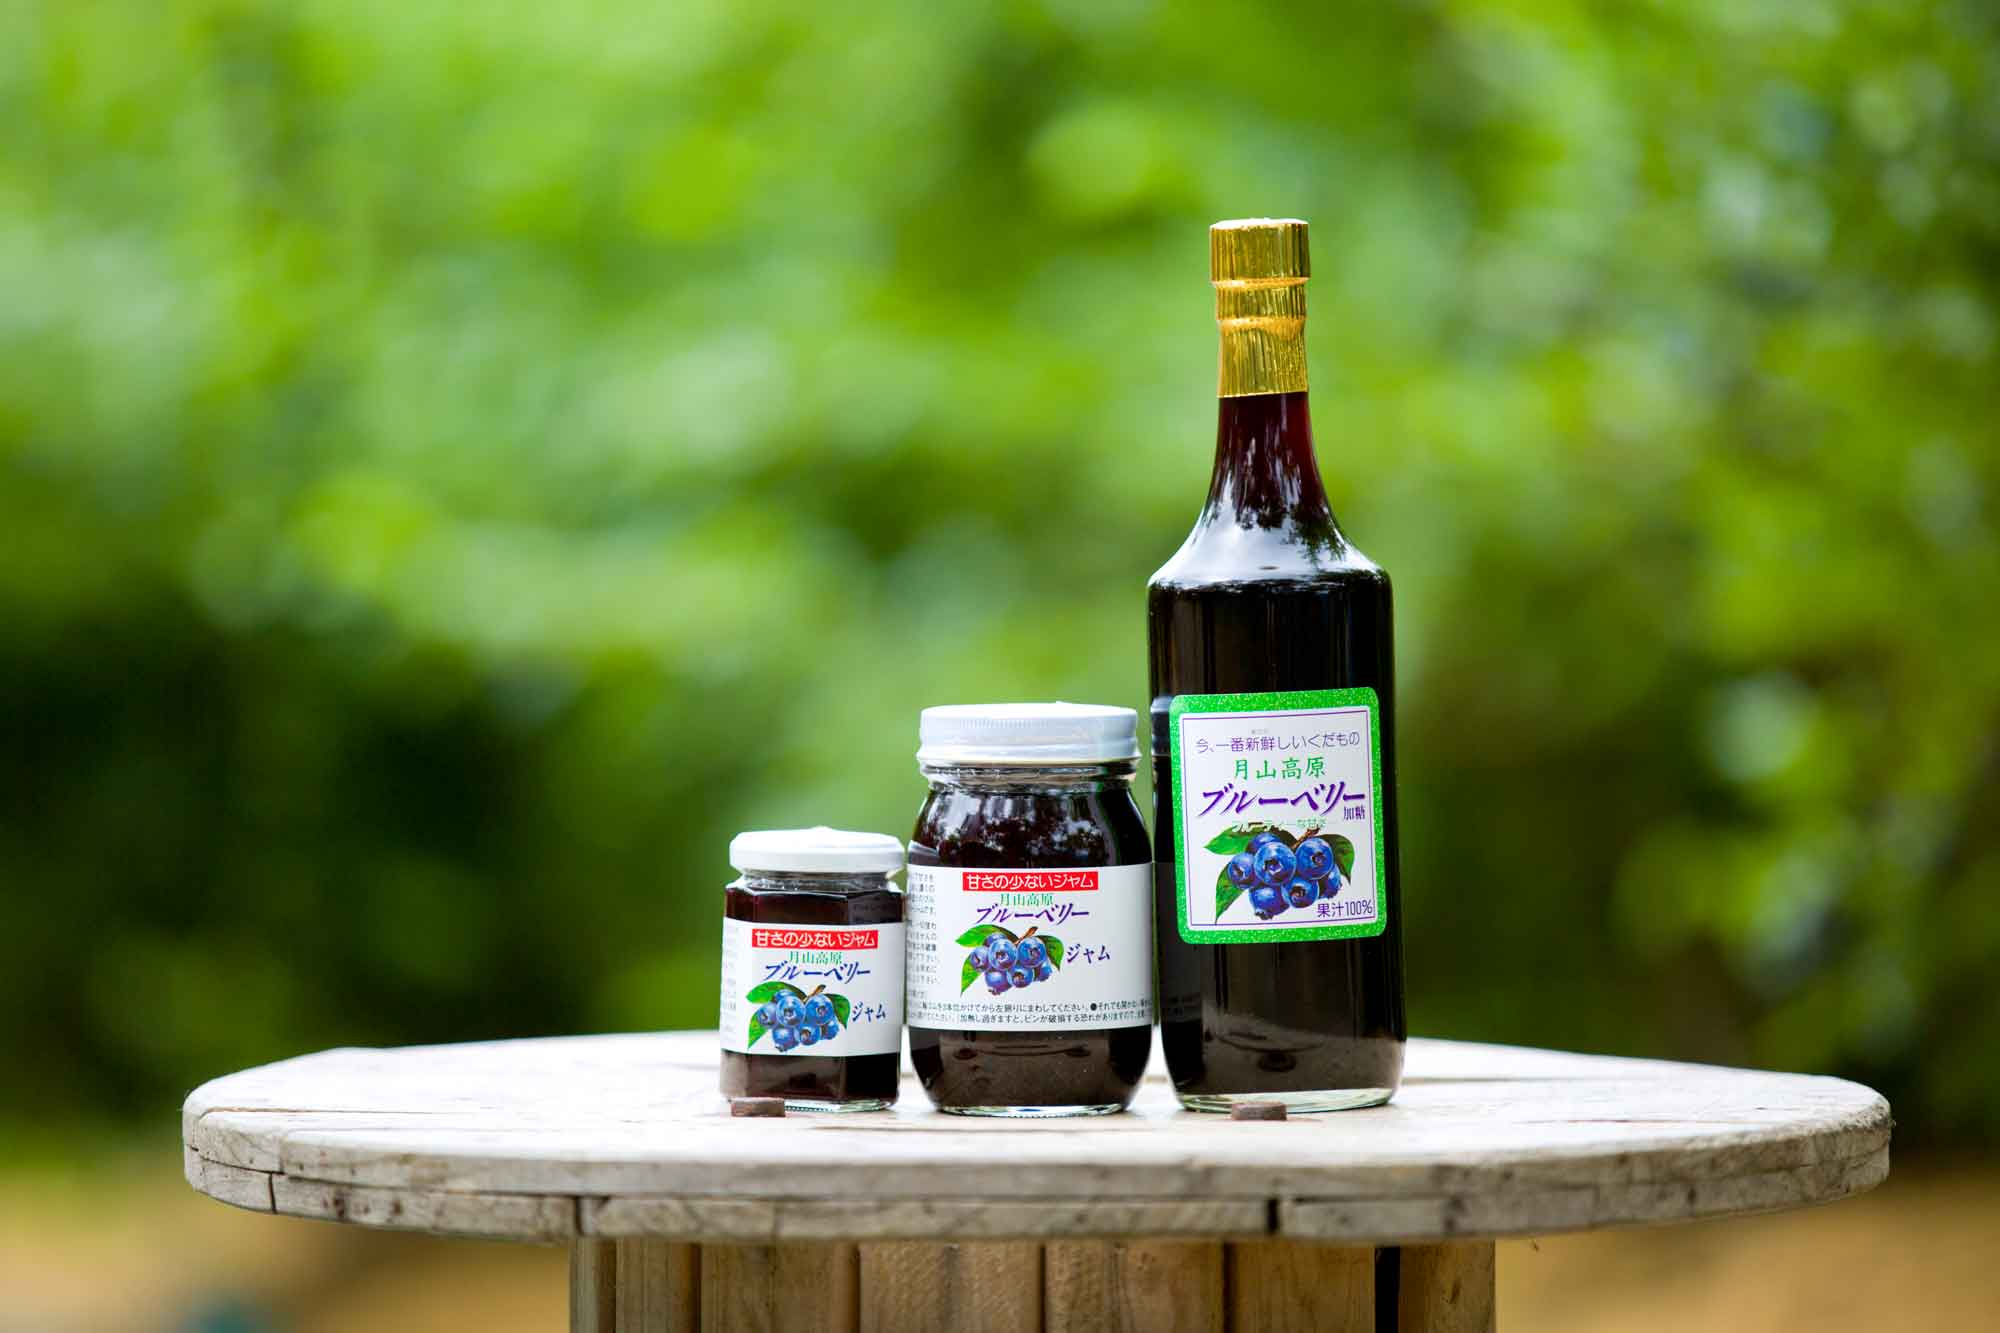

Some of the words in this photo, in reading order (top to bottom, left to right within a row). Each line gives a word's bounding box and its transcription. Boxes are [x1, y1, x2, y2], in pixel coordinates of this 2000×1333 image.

[1233, 756, 1326, 780] 月山高原
[1197, 781, 1366, 817] ブルーベリー
[1343, 806, 1366, 821] 加糖
[966, 873, 1094, 890] 甘さの少ないジャム
[999, 893, 1054, 906] 月山高原
[1317, 899, 1373, 918] 果汁100%
[975, 903, 1090, 926] ブルーベリー
[754, 931, 876, 948] 甘さの少ないジャム
[789, 951, 844, 965] 月山高原
[1066, 943, 1111, 964] ジャム
[763, 960, 871, 984] ブルーベリー
[851, 1002, 887, 1023] ジャム
